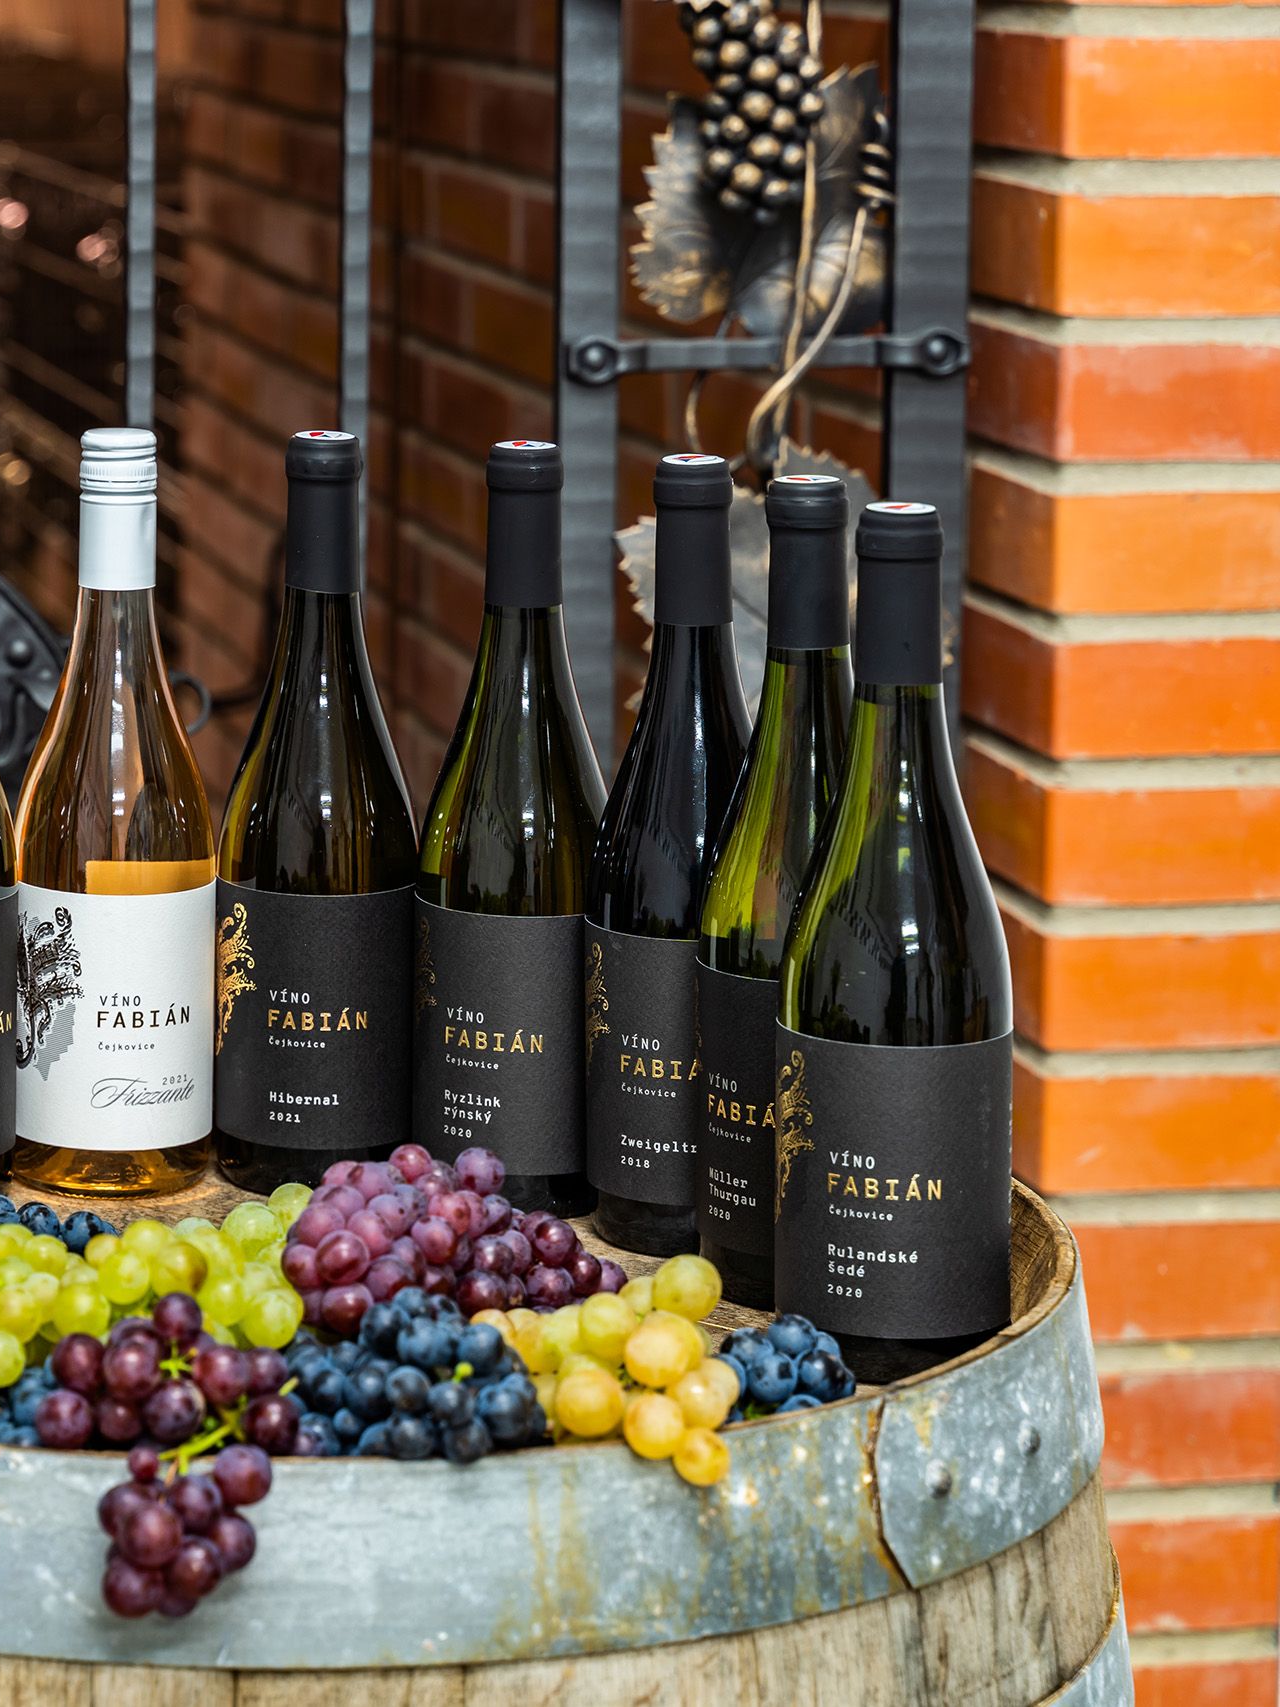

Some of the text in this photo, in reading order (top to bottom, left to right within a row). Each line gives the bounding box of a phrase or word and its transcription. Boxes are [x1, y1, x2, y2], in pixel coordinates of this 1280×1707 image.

[100, 993, 141, 1007] VÍNO
[269, 988, 310, 1004] VÍNO
[97, 1003, 190, 1028] FABIÁN
[267, 1007, 368, 1032] FABIÁN
[447, 1006, 484, 1024] VÍNO
[98, 1041, 155, 1052] Čejkovice
[268, 1035, 326, 1048] Čejkovice
[445, 1025, 543, 1054] FABIÁN
[622, 1033, 660, 1051] VÍNO
[446, 1054, 499, 1070] Čejkovice
[162, 1074, 188, 1086] 2021
[709, 1072, 738, 1093] VÍNO
[90, 1077, 195, 1109] Frizzante
[269, 1091, 340, 1105] Hibernal
[444, 1089, 501, 1108] Ryzlink
[621, 1082, 677, 1098] Čejkovice
[269, 1111, 301, 1123] 2021
[444, 1106, 492, 1125] rýnský
[443, 1124, 472, 1139] 2020
[708, 1121, 752, 1144] Čejkovice
[621, 1155, 651, 1169] 2018
[829, 1150, 876, 1170] VÍNO
[708, 1166, 748, 1189] Müller
[708, 1182, 757, 1208] Thurgau
[827, 1172, 943, 1202] FABIÁN
[708, 1204, 731, 1221] 2020
[828, 1204, 894, 1221] Čejkovice
[827, 1243, 919, 1264] Rulandské
[828, 1260, 865, 1278] šedé
[827, 1283, 863, 1299] 2020
